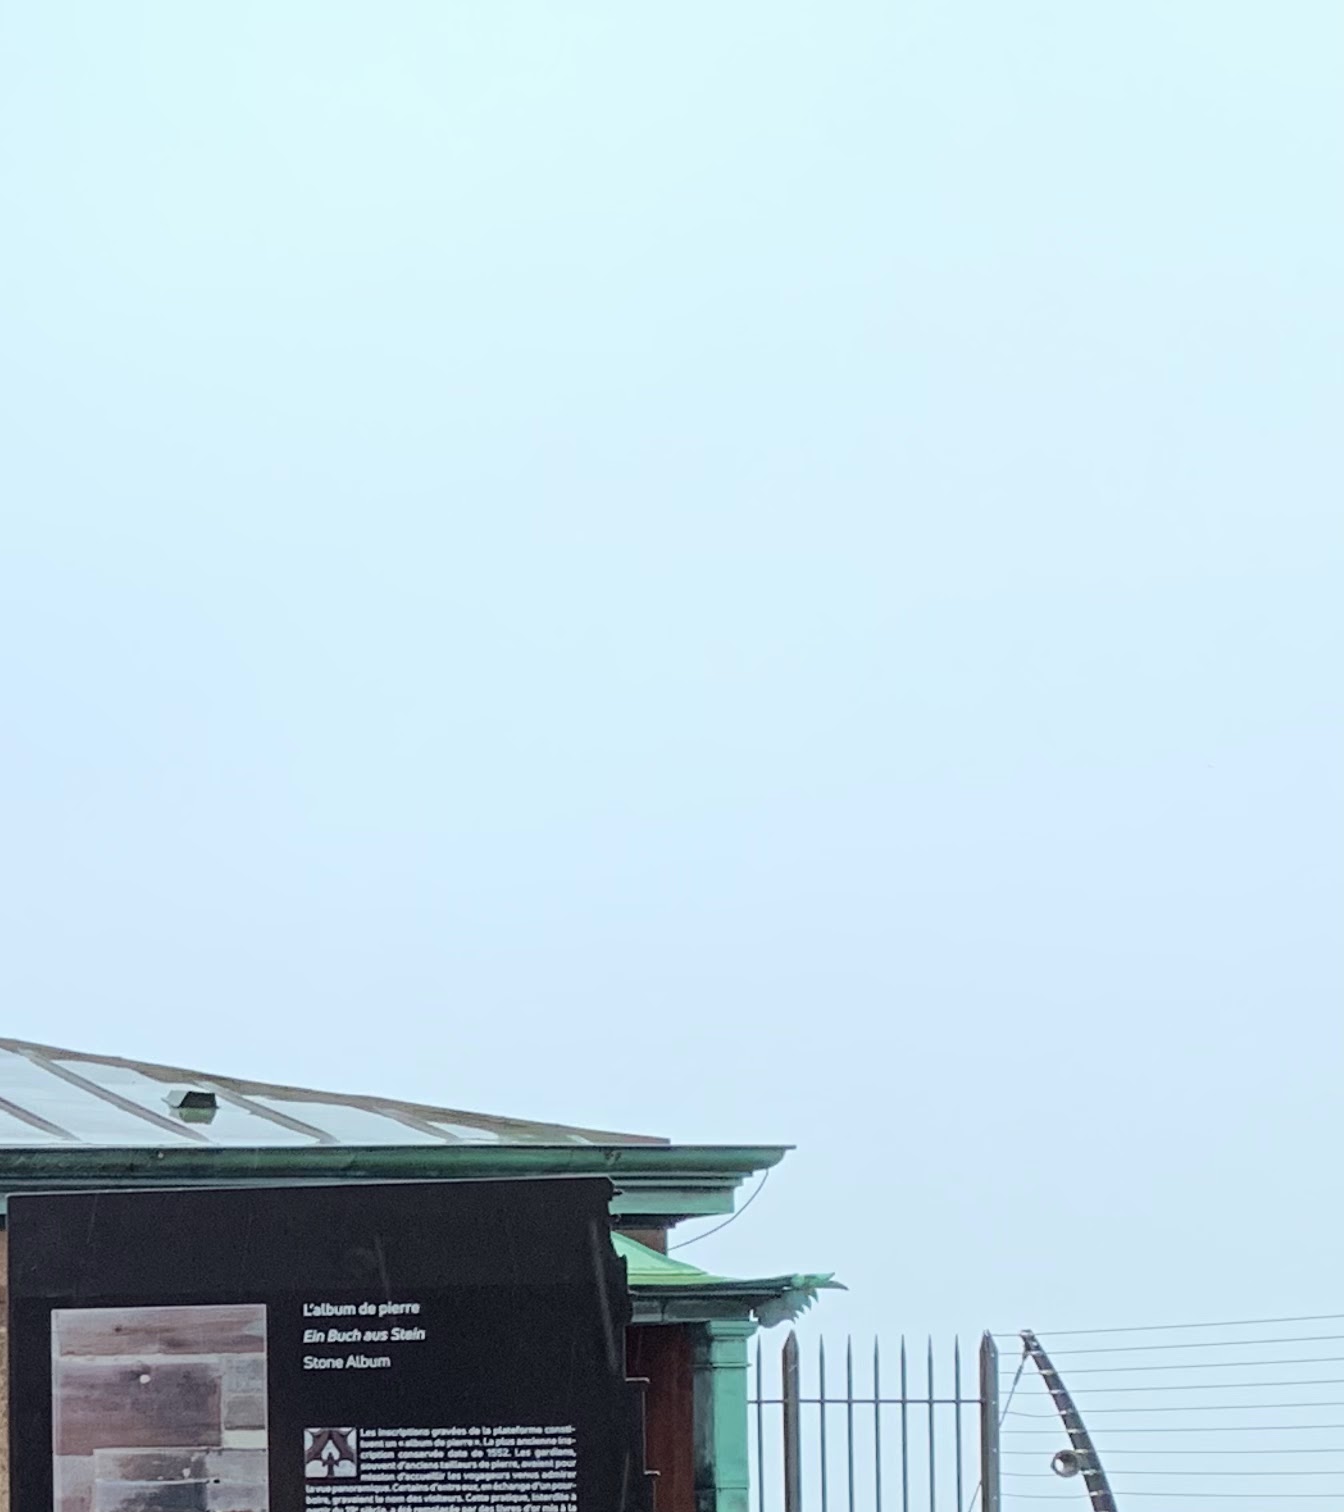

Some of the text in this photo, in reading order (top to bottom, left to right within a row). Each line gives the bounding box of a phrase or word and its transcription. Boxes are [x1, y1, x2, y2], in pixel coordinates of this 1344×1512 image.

[303, 1301, 420, 1317] L'album de pierre
[304, 1327, 426, 1343] Ein Buch aus Stein
[304, 1355, 391, 1369] Stone Album
